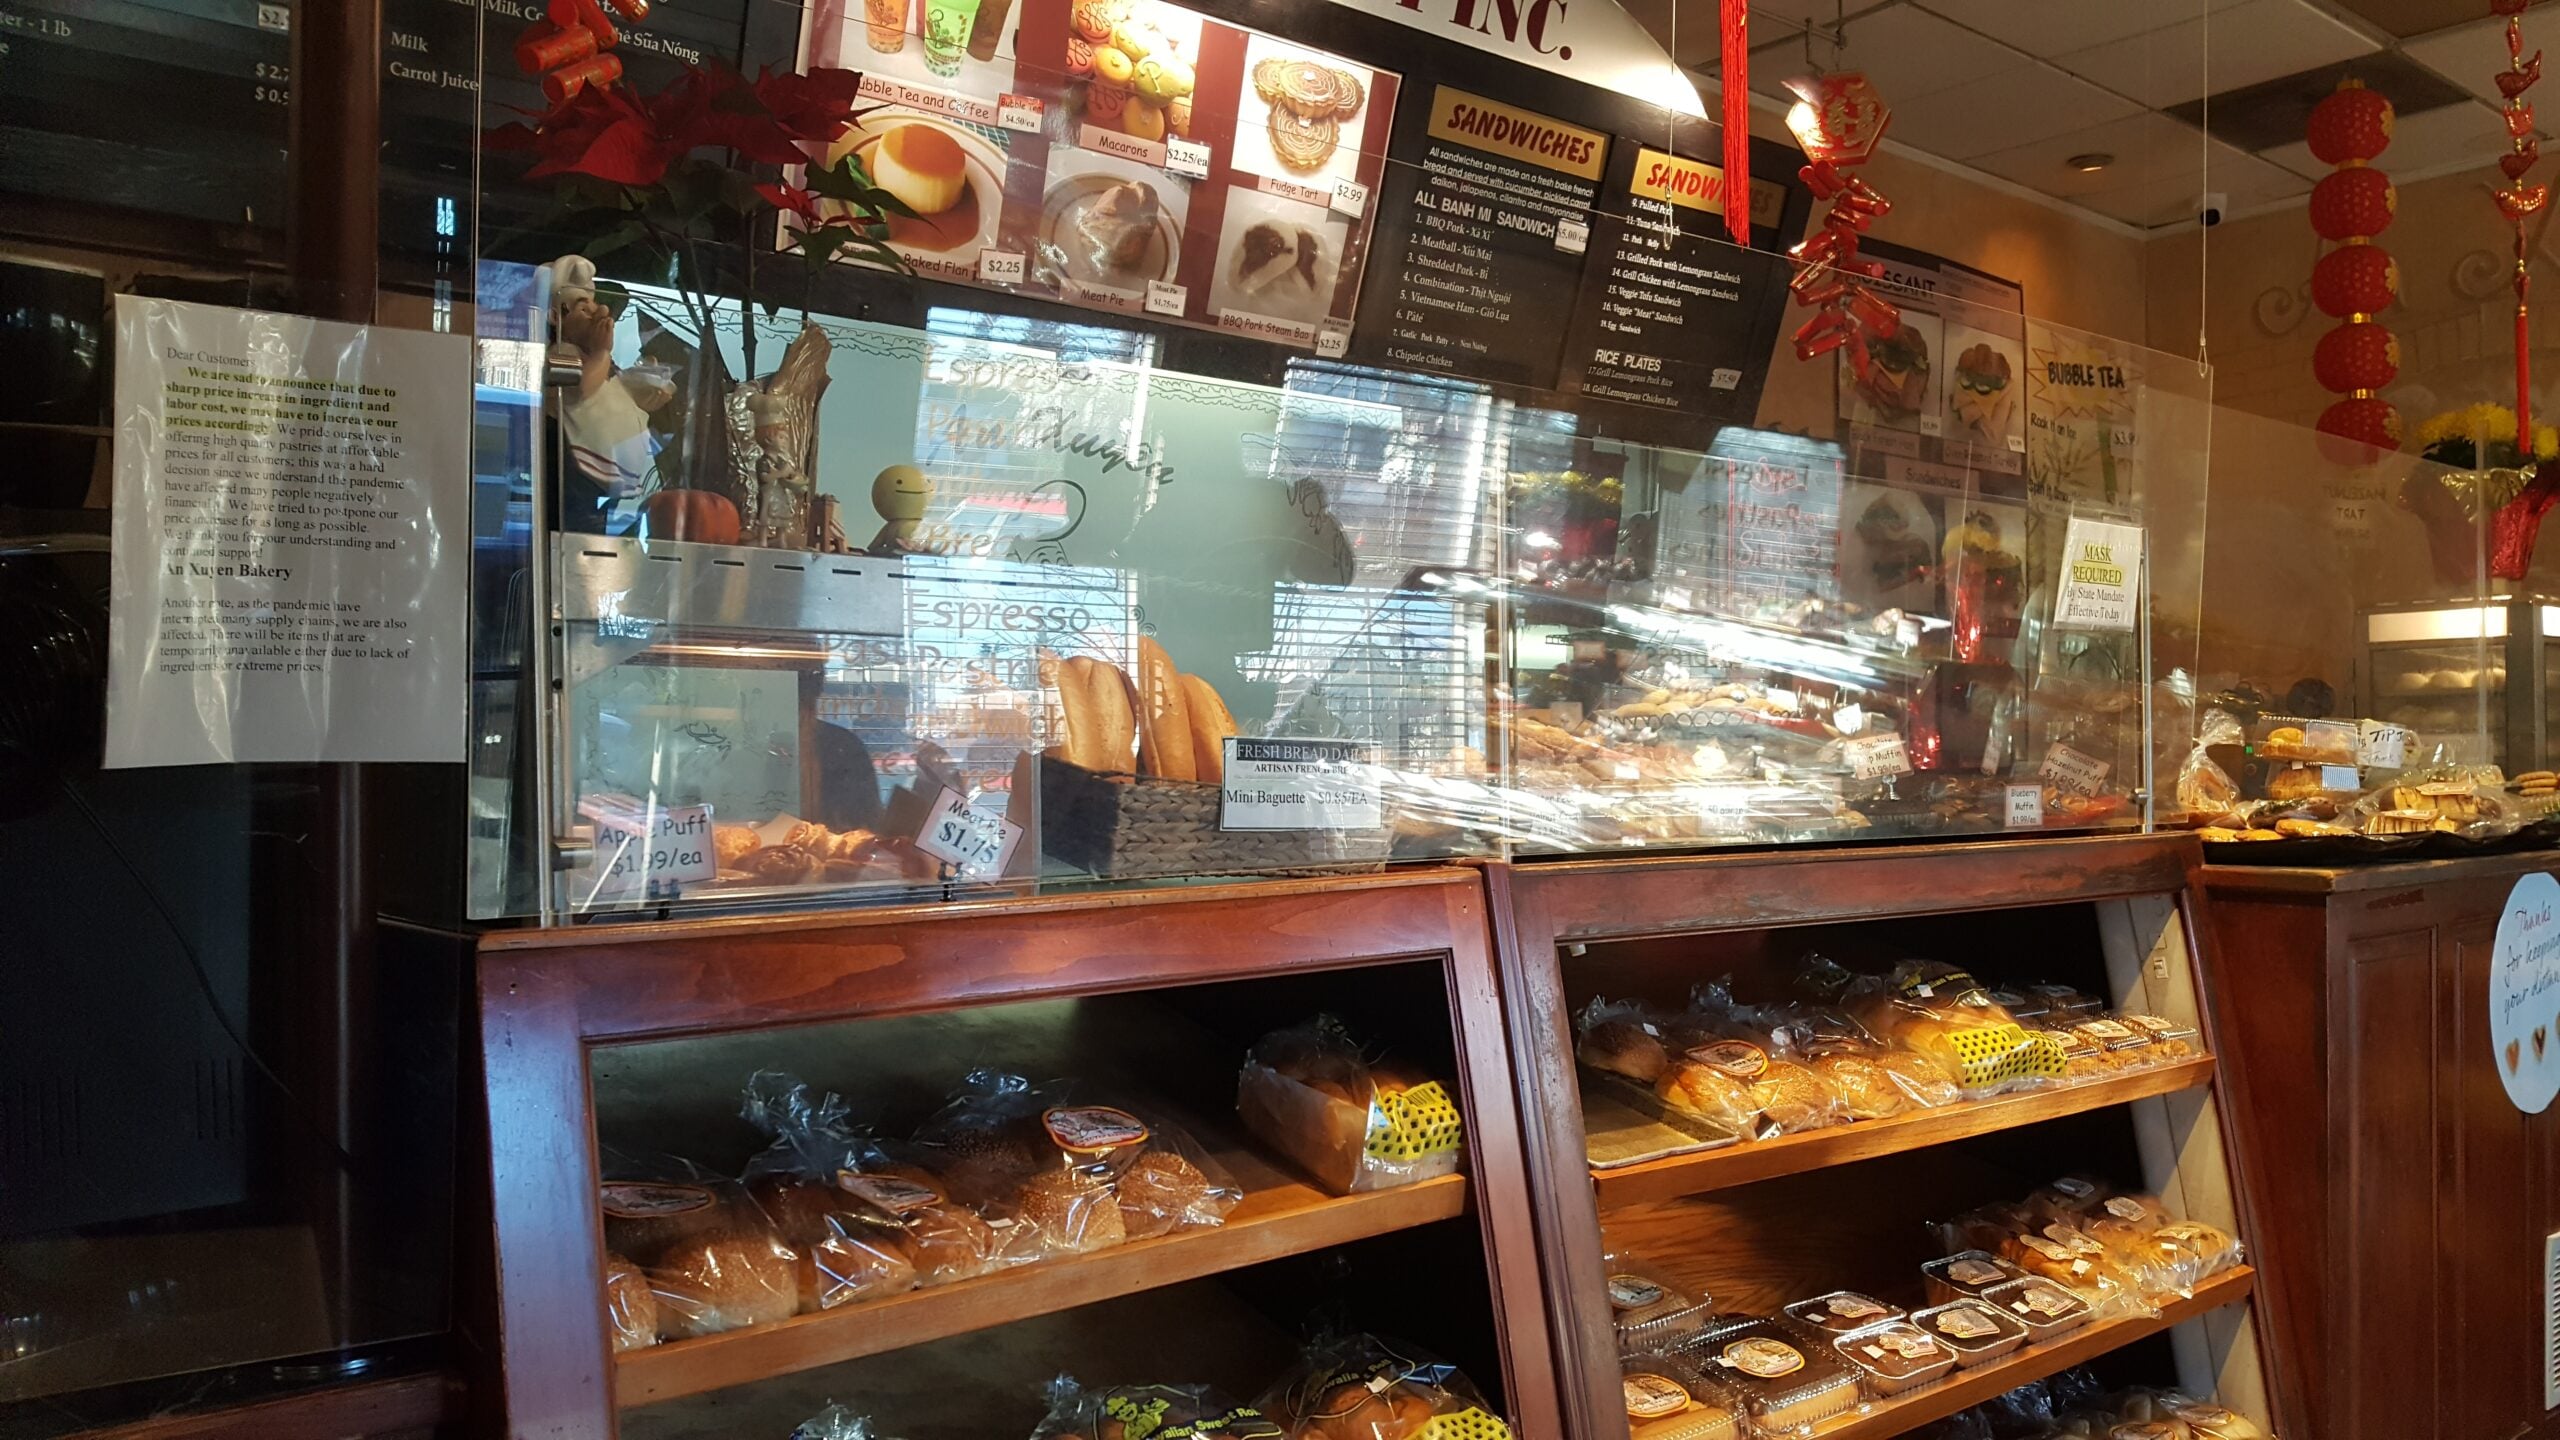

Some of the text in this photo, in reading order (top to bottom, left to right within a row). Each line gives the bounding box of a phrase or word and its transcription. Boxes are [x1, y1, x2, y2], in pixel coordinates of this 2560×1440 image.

[1449, 0, 1573, 60] INC.
[391, 32, 429, 53] Milk
[390, 62, 480, 91] Carrot Juice
[898, 86, 919, 103] Tea
[922, 94, 944, 109] and
[1001, 97, 1025, 110] Bubble
[1448, 104, 1595, 164] SANDWICHES
[1099, 135, 1148, 158] Macarons
[1167, 148, 1208, 167] $2.25/ea
[1423, 160, 1489, 184] bread served
[1440, 148, 1483, 168] sandwiches
[1484, 162, 1497, 171] are
[1499, 165, 1519, 178] made
[1538, 174, 1554, 186] fresh
[1555, 177, 1572, 191] bake
[1270, 178, 1319, 200] Fudge Tart
[1336, 184, 1363, 202] $2.99
[1431, 176, 1584, 221] daikon, jalapenos, cilantro and mayonnaise
[1414, 190, 1556, 238] ALL BANH MI SANDWICH
[1426, 215, 1465, 235] BBQ Pork
[1421, 235, 1457, 253] Meatball
[904, 253, 968, 277] Baked Flan
[988, 260, 1020, 273] $2.25
[1417, 254, 1474, 276] Shredded Pork
[1627, 253, 1741, 284] Grilled Pork Lemongrass Sandwich
[1414, 273, 1465, 294] Combination
[1637, 272, 1661, 287] Chicken
[1081, 288, 1125, 306] Meat Pie
[1411, 291, 1475, 315] Vietnamese Ham
[1619, 286, 1681, 308] Veggie Sandwich
[1223, 314, 1309, 341] BBQ Pork Steam Bao
[1655, 312, 1684, 325] Sandwich
[1319, 337, 1341, 350] $2.25
[167, 348, 193, 361] Dear
[1395, 349, 1453, 368] Chipotle Chicken
[1595, 348, 1662, 372] RICE PLATES
[188, 366, 396, 397] We are sad that due to
[2048, 362, 2125, 388] BUBBLE TEA
[166, 382, 390, 412] sharp price ingredient and
[166, 397, 398, 429] labor cost, have increase our
[166, 414, 330, 440] prices pride
[165, 432, 323, 454] offering high pastries
[164, 450, 199, 462] prices
[202, 450, 219, 461] for
[298, 457, 320, 468] this
[359, 461, 385, 473] hard
[164, 465, 405, 493] decision understand pandemic
[240, 487, 374, 506] many people negatively
[278, 502, 305, 515] tried
[164, 514, 369, 534] price long possible.
[217, 532, 396, 551] you understanding and
[2083, 545, 2112, 562] MASK
[239, 563, 293, 581] Bakery
[2072, 565, 2122, 584] REQUIRED
[2078, 587, 2125, 602] State Mandate
[273, 600, 361, 615] pandemic have
[906, 588, 1091, 638] Espresso
[2068, 604, 2120, 622] Effective Today
[255, 616, 408, 630] supply we also
[244, 630, 267, 640] will
[330, 646, 394, 659] due lack
[236, 662, 324, 674] extreme prices.
[1237, 744, 1328, 760] FRESH BREAD
[2061, 748, 2098, 770] Chocolate
[1254, 764, 1293, 772] ARTISAN
[2047, 754, 2082, 774] Hazelnut
[1225, 790, 1305, 807] Mini Baguette
[948, 800, 984, 824] Meat
[663, 814, 708, 838] Puff
[939, 821, 998, 864] $1.75
